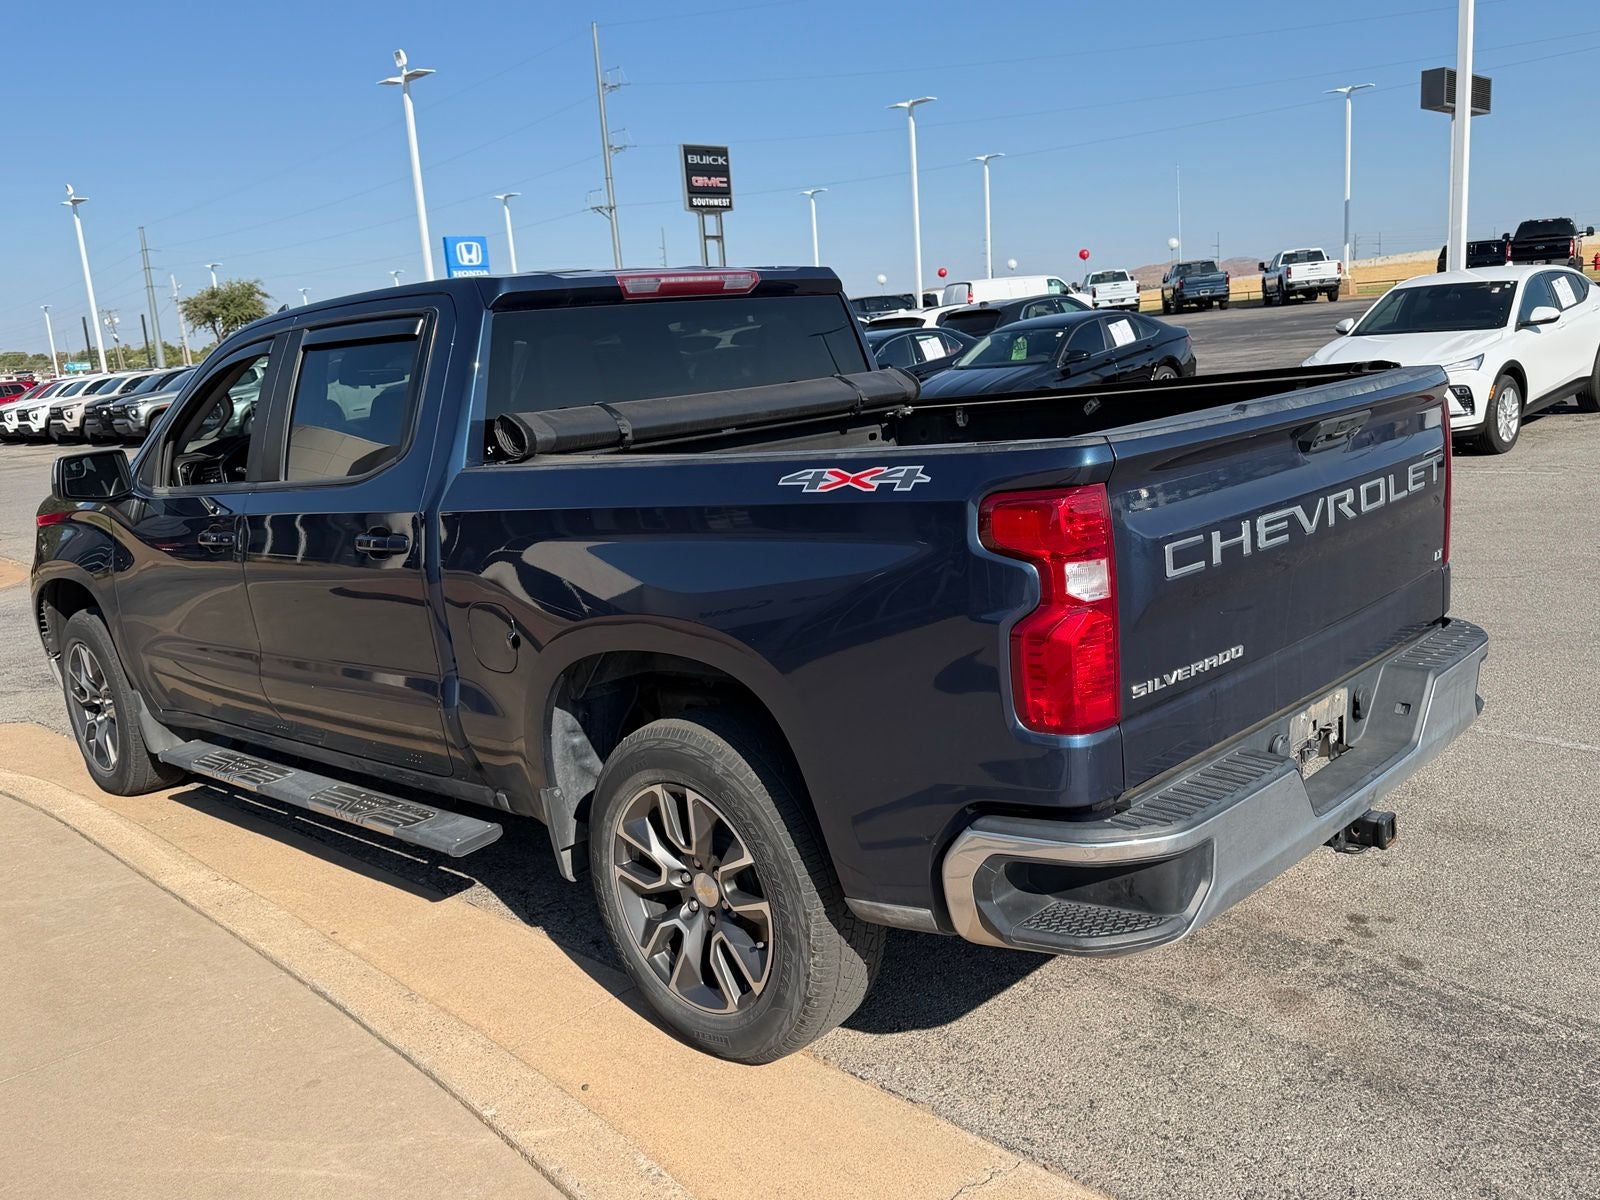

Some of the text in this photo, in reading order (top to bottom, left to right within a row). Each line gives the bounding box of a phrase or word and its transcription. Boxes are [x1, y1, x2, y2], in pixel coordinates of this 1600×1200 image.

[687, 154, 728, 165] BUICK
[691, 175, 728, 188] GMC
[692, 197, 730, 207] SOUTHWEST
[1164, 450, 1444, 578] CHEVROLET
[1131, 644, 1244, 699] SILVERADO
